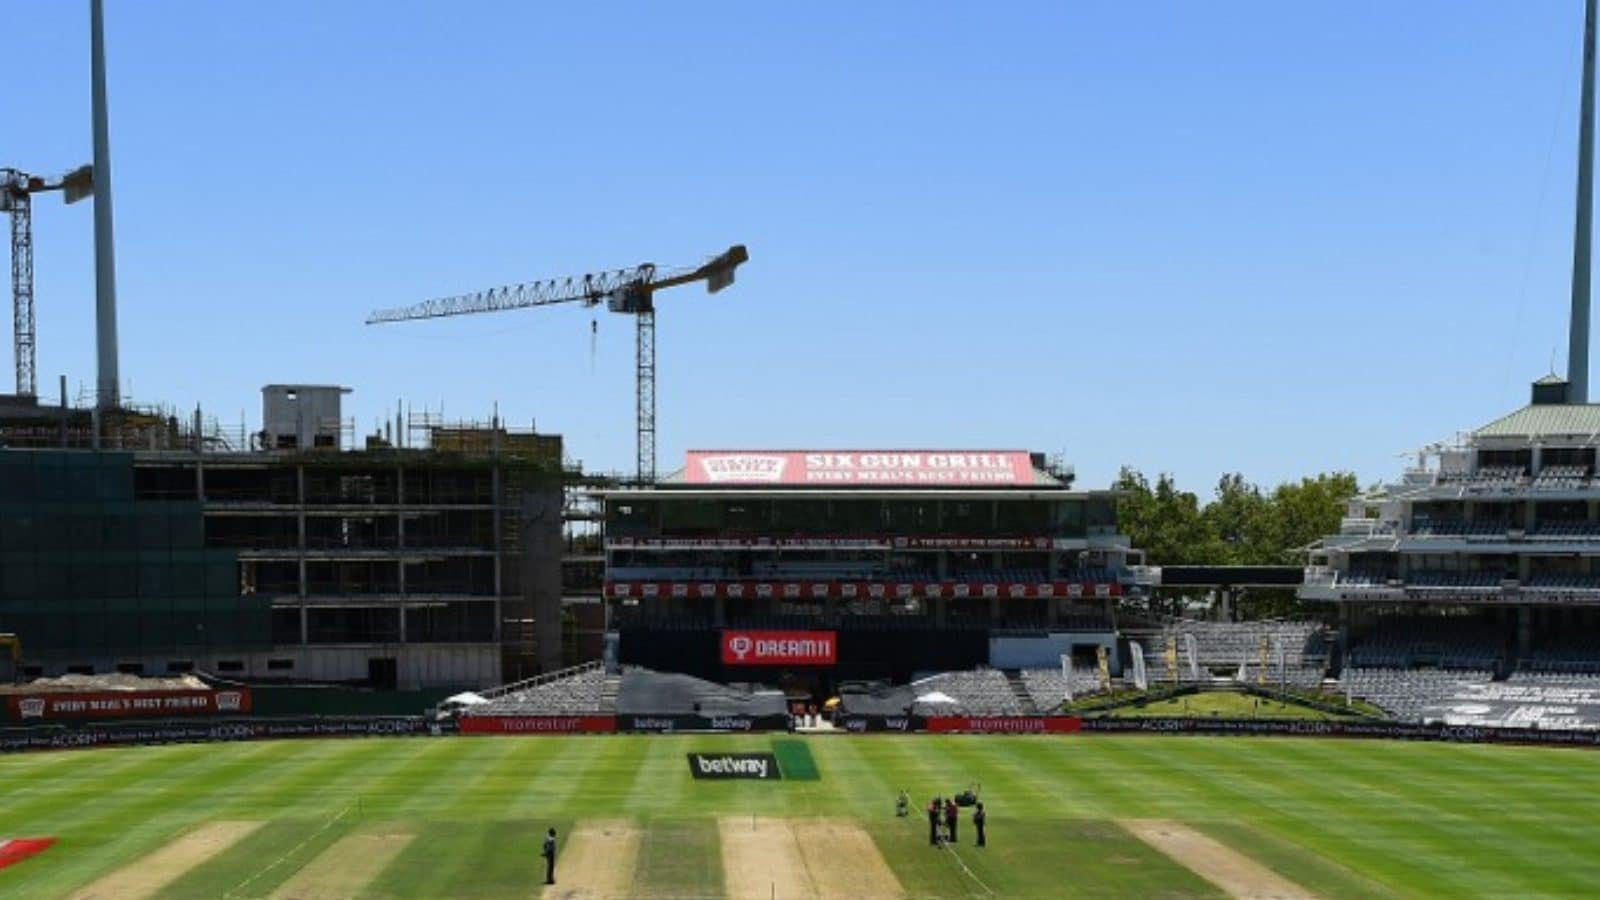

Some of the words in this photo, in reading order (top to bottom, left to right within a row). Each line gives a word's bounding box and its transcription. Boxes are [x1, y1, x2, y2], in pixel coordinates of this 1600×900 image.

[805, 453, 854, 468] SIX
[860, 453, 920, 468] GUN
[927, 453, 1014, 468] GRILL
[806, 471, 851, 480] EVERY
[857, 471, 913, 480] MEAL'S
[918, 471, 954, 480] BEST
[755, 639, 832, 657] DREAM11
[53, 700, 86, 712] EVERY
[133, 698, 161, 708] BEST
[367, 720, 414, 732] ACORN
[634, 717, 673, 730] betway
[712, 717, 752, 730] betway
[697, 755, 768, 777] betway
